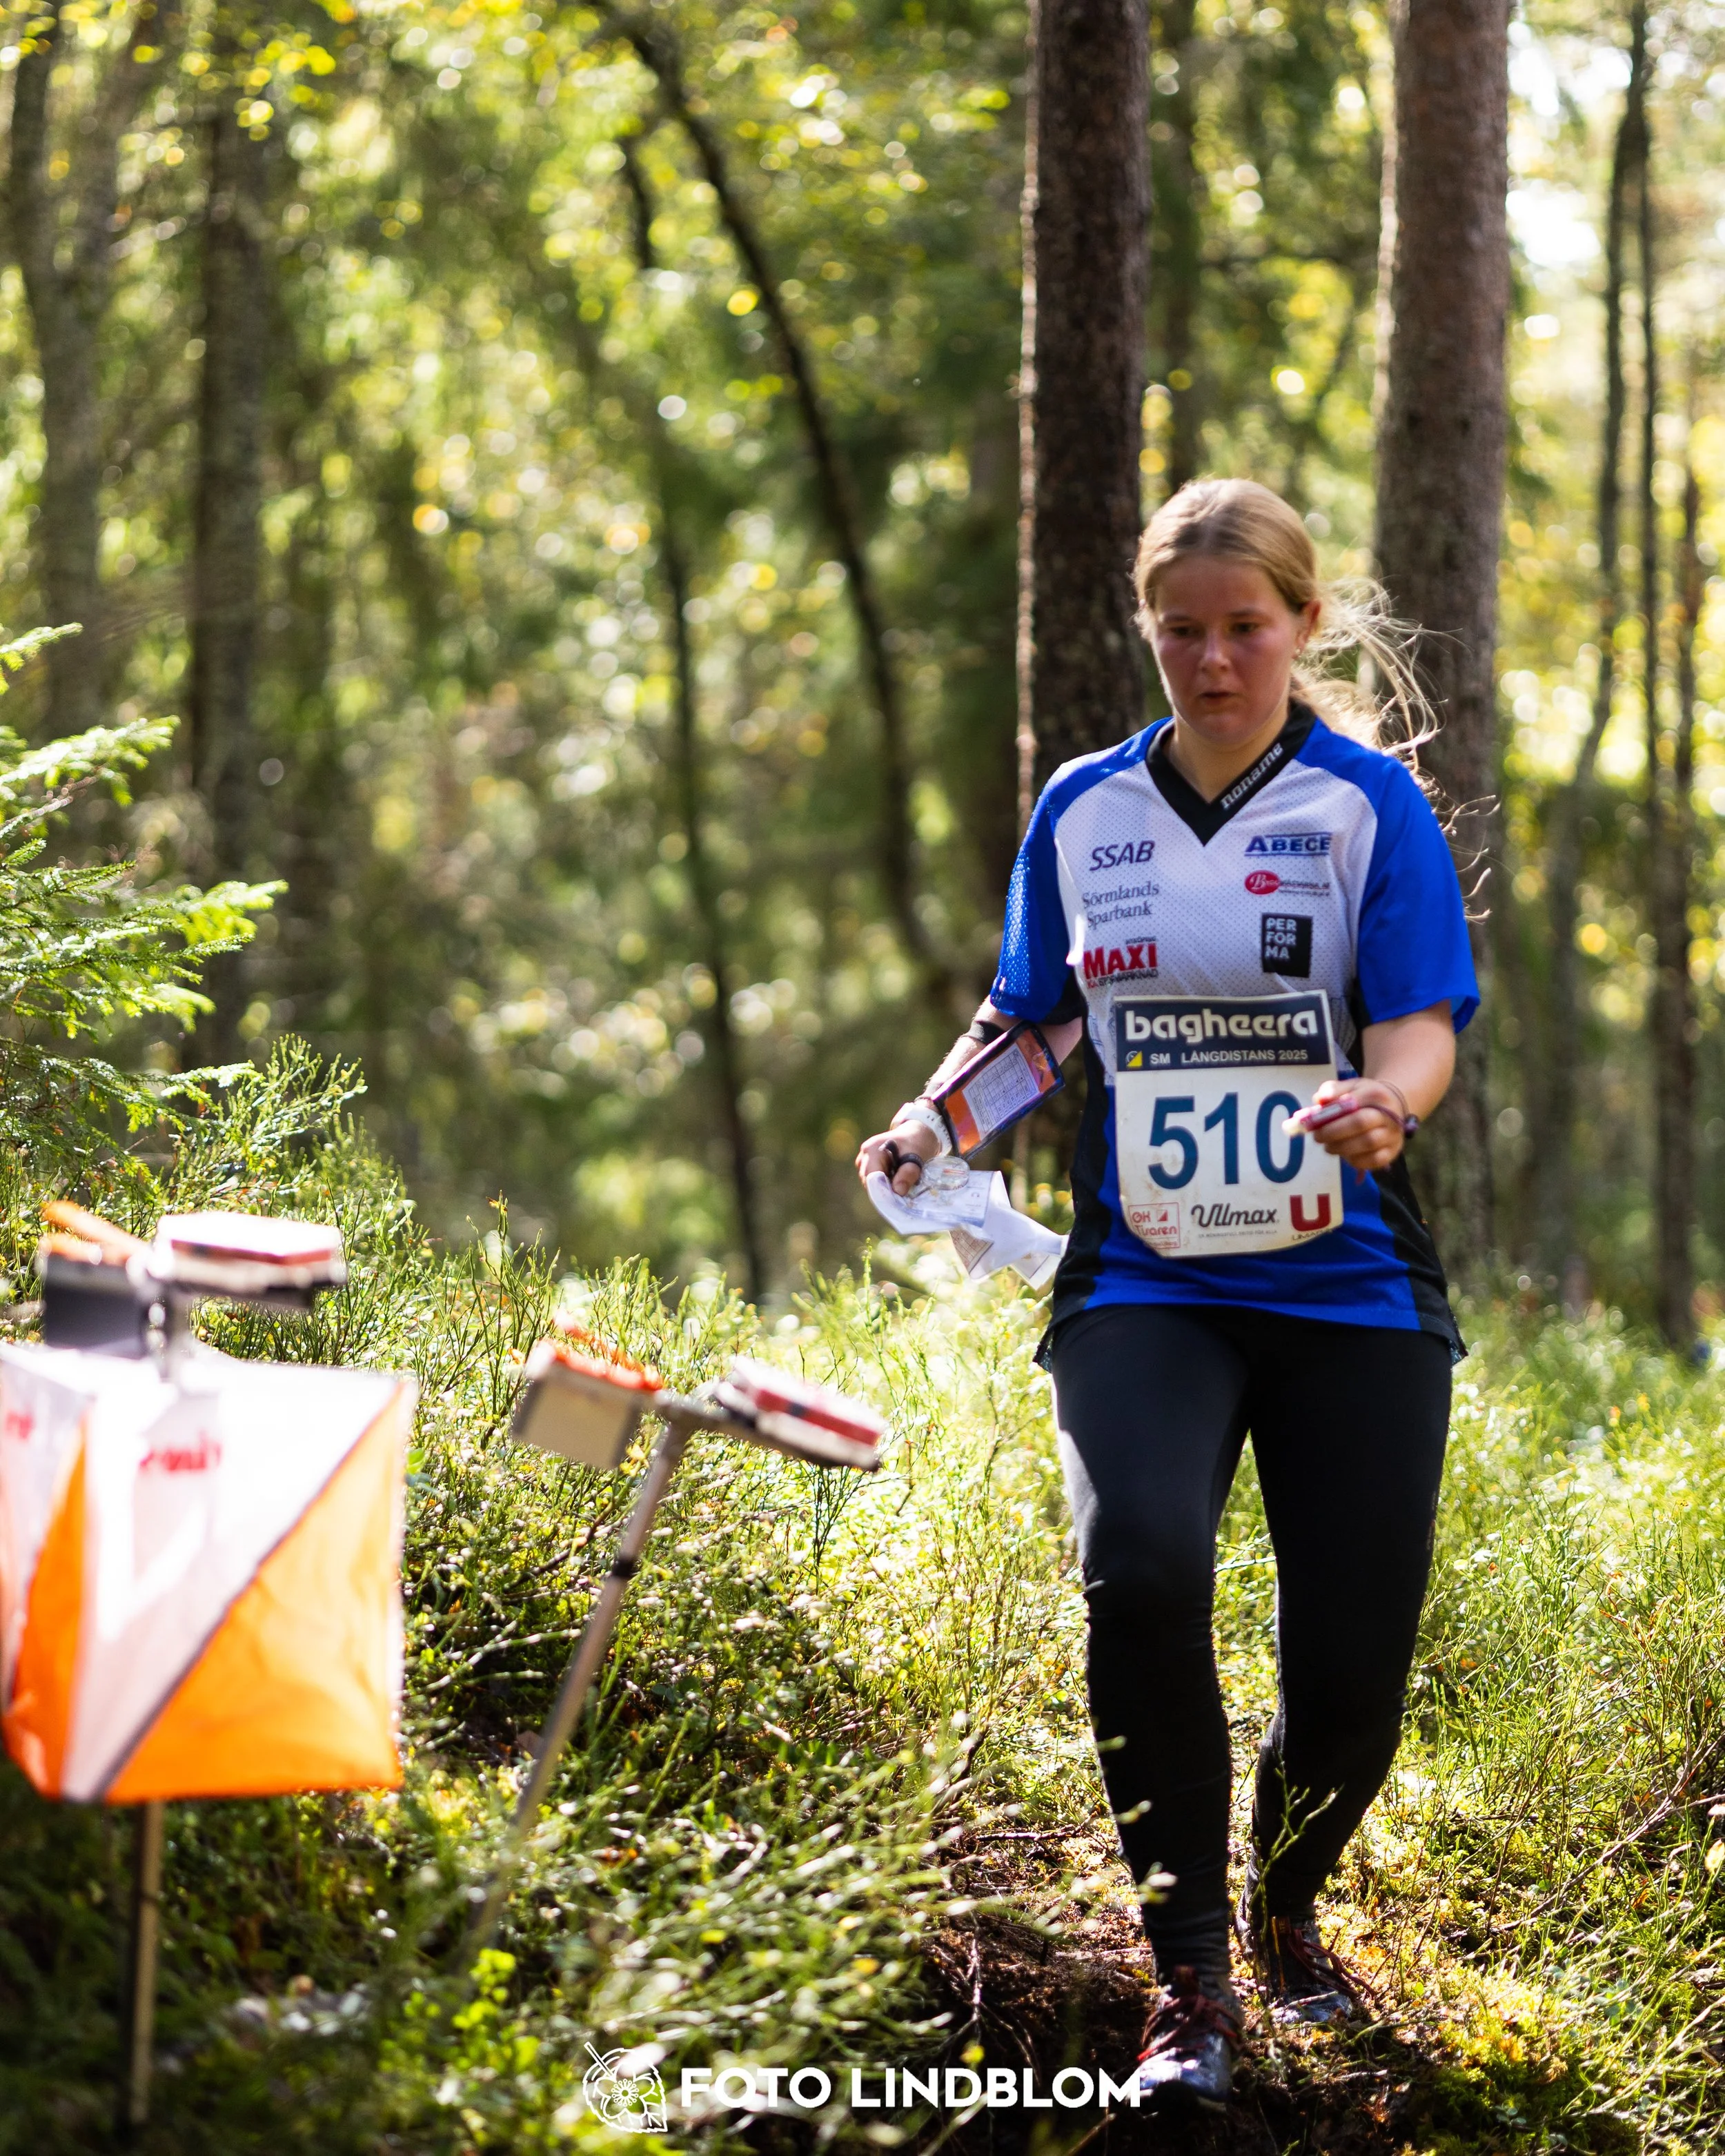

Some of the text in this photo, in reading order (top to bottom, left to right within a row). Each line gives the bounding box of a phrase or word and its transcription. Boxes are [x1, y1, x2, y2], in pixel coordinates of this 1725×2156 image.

[1220, 742, 1283, 809] noname
[1090, 840, 1156, 871] SSAB
[1245, 835, 1332, 853] ABECE
[1082, 880, 1160, 909] Sörmlands
[1087, 900, 1153, 930] Sparbank
[1265, 918, 1297, 931] PER
[1264, 931, 1297, 945] FOR
[1264, 945, 1290, 960] MA
[1083, 943, 1158, 980] MAXI
[1125, 1009, 1319, 1044] bagheera
[1150, 1049, 1308, 1065] SM LÅNGDISTANS 2025
[1147, 1089, 1305, 1190] 510
[1191, 1203, 1277, 1228] Ullmax
